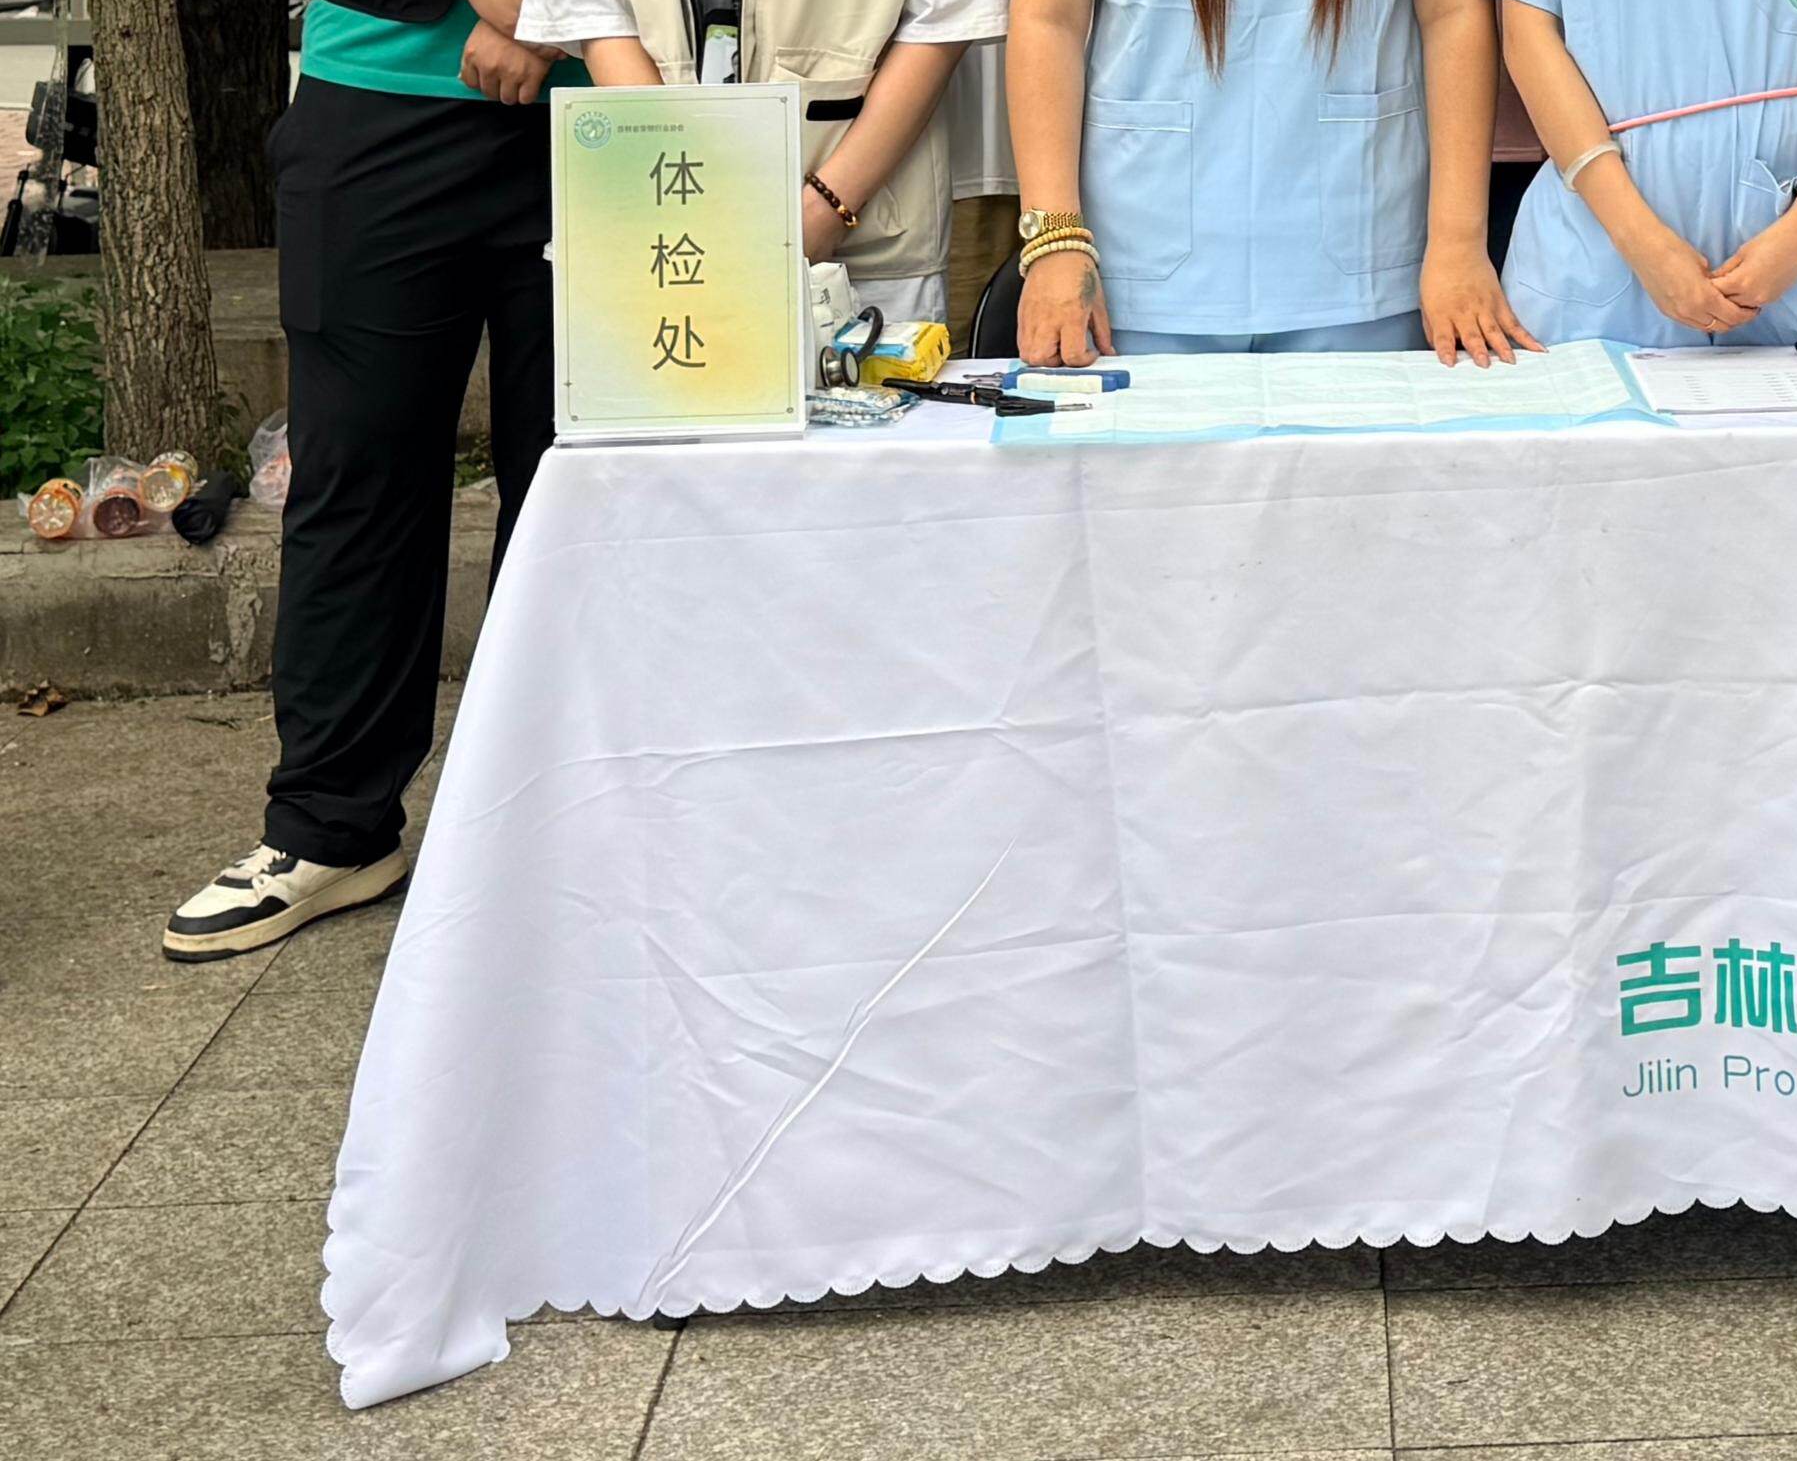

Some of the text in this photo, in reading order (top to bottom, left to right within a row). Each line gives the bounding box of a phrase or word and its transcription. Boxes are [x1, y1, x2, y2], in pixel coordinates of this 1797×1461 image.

[649, 149, 707, 372] 体检处
[1622, 1057, 1698, 1098] Jilin
